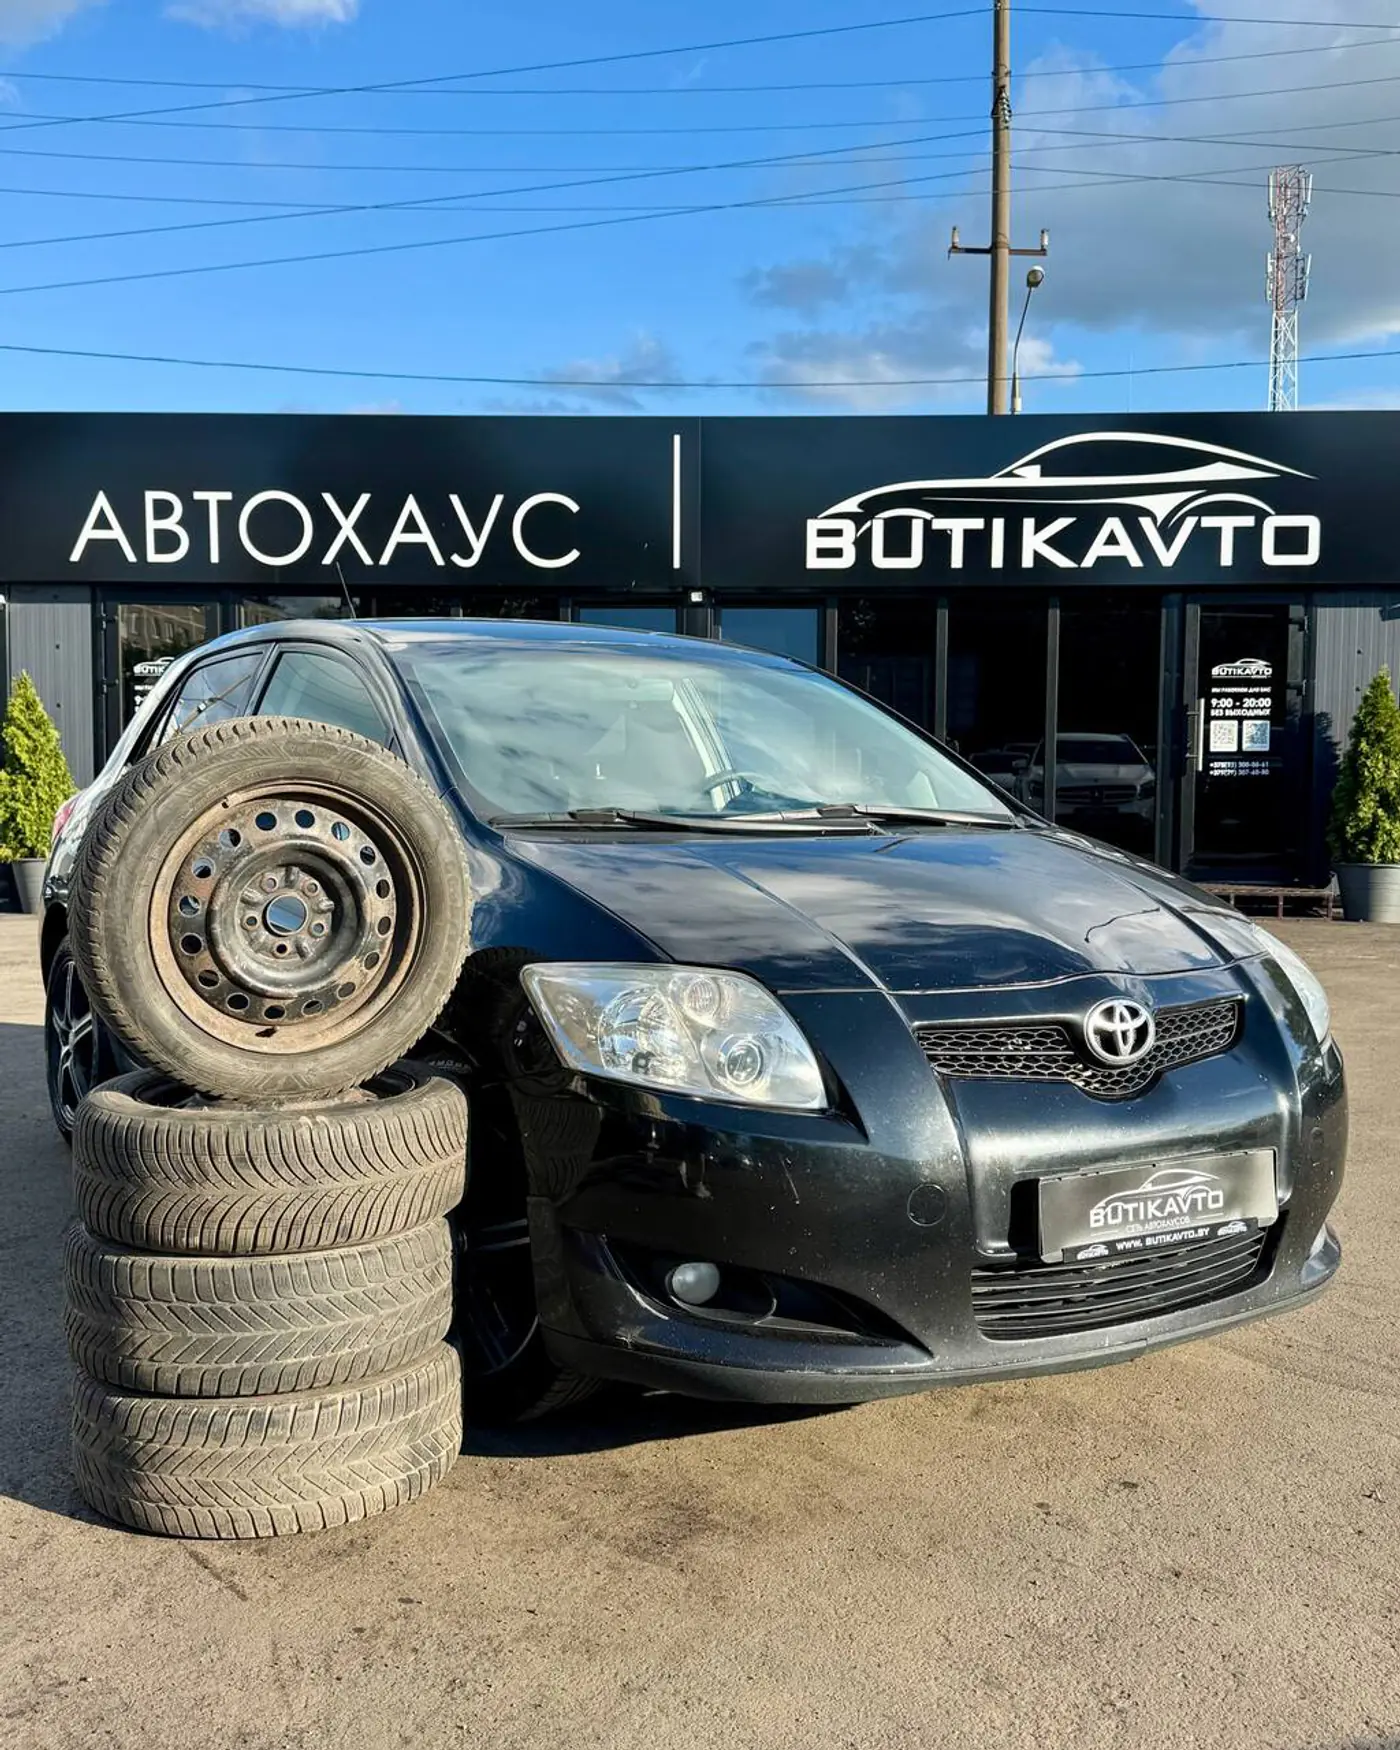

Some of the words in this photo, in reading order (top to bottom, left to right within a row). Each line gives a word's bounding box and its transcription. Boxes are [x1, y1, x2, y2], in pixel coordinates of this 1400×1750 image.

[69, 490, 580, 568] АВТОХАУС
[806, 514, 1321, 569] BUTIKAVTO
[133, 665, 165, 674] BUTIK
[1211, 667, 1273, 676] BUTIKAVTO
[1211, 698, 1233, 708] 9:00
[1242, 697, 1272, 708] 20:00
[1089, 1190, 1224, 1228] BUTIKAVTO
